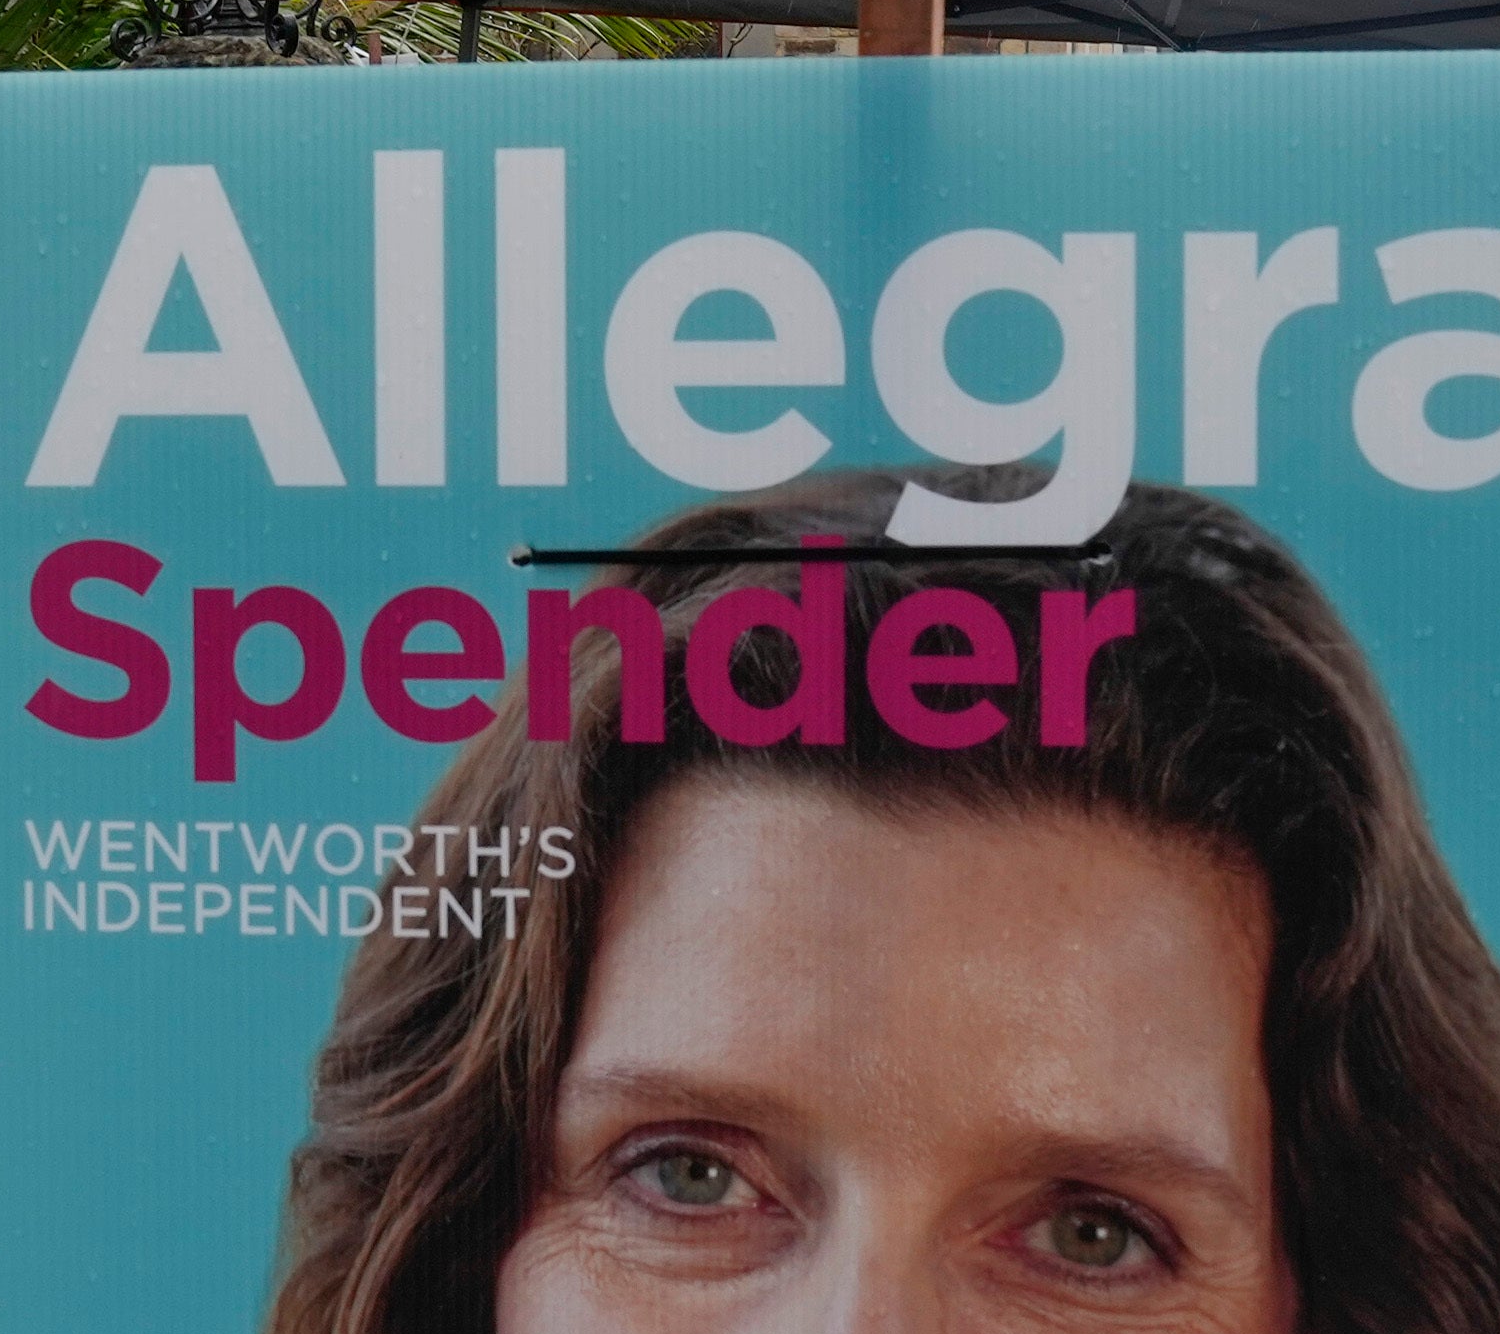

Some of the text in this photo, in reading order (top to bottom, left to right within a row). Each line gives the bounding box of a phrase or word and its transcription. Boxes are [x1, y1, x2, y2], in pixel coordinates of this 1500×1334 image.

[24, 535, 1138, 781] Spender
[24, 820, 575, 880] WENTWORTH'S
[21, 881, 529, 939] INDEPENDENT
